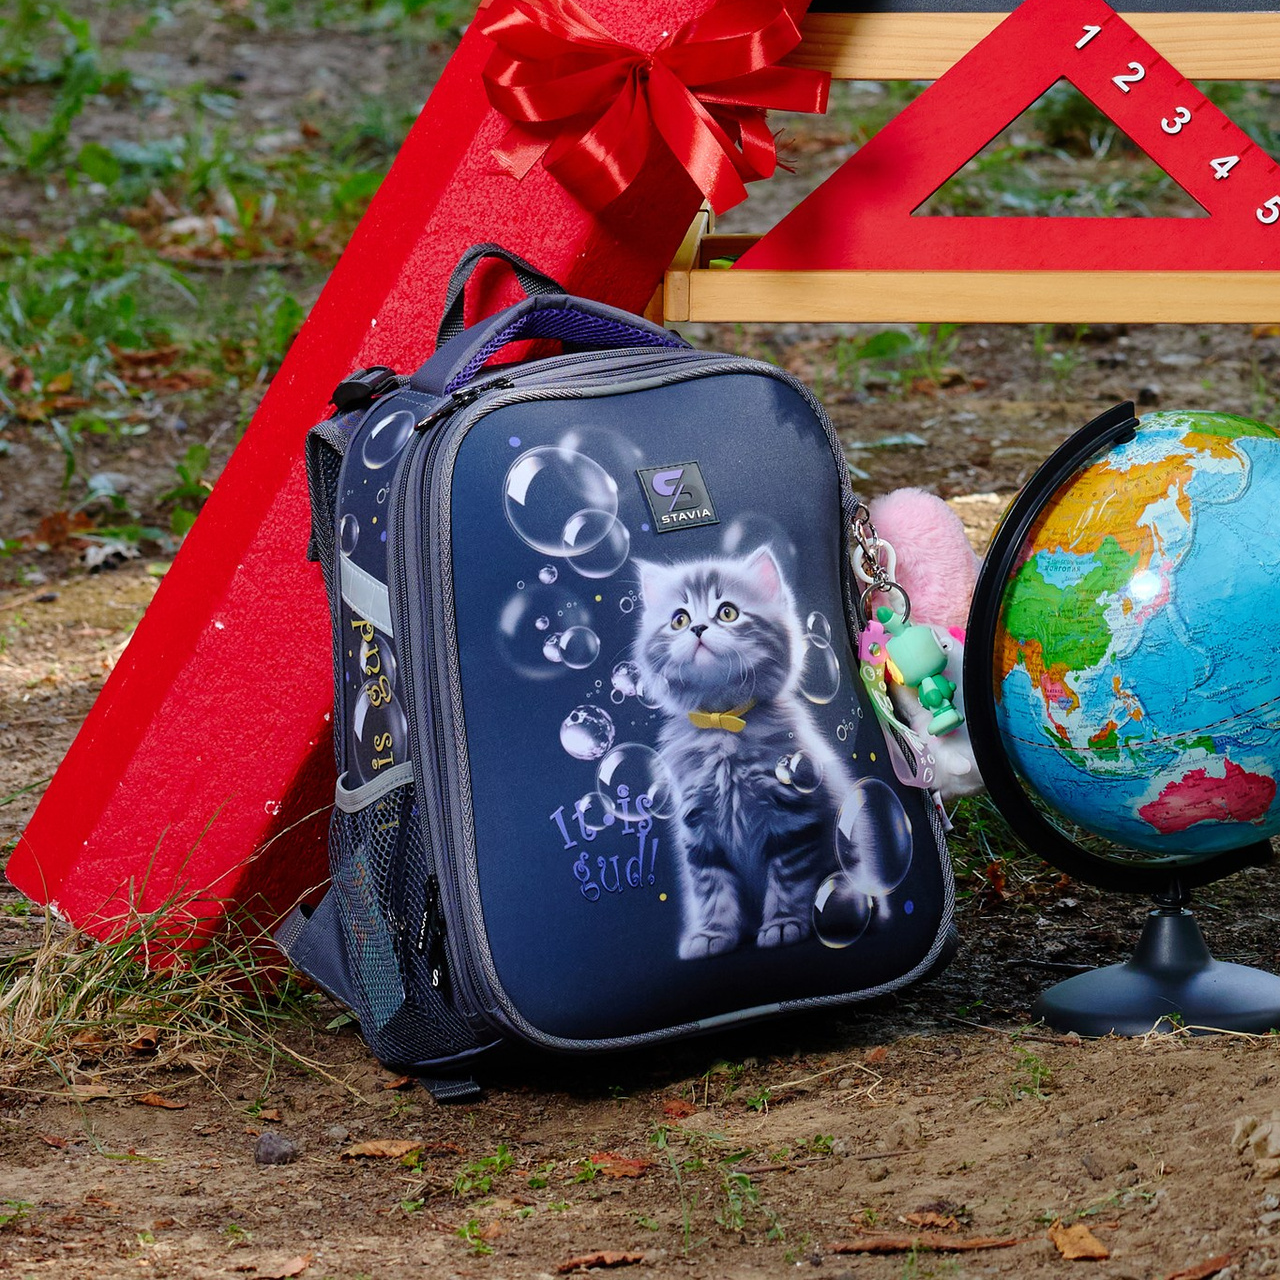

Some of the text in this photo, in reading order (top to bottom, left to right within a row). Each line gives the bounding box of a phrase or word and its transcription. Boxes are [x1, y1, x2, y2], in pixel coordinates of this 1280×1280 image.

[1075, 24, 1102, 50] 1
[1111, 61, 1147, 94] 2
[1161, 106, 1192, 135] 3
[1210, 155, 1241, 180] 4
[661, 508, 712, 524] STAVIA
[550, 784, 653, 849] It is
[573, 830, 659, 901] gud!
